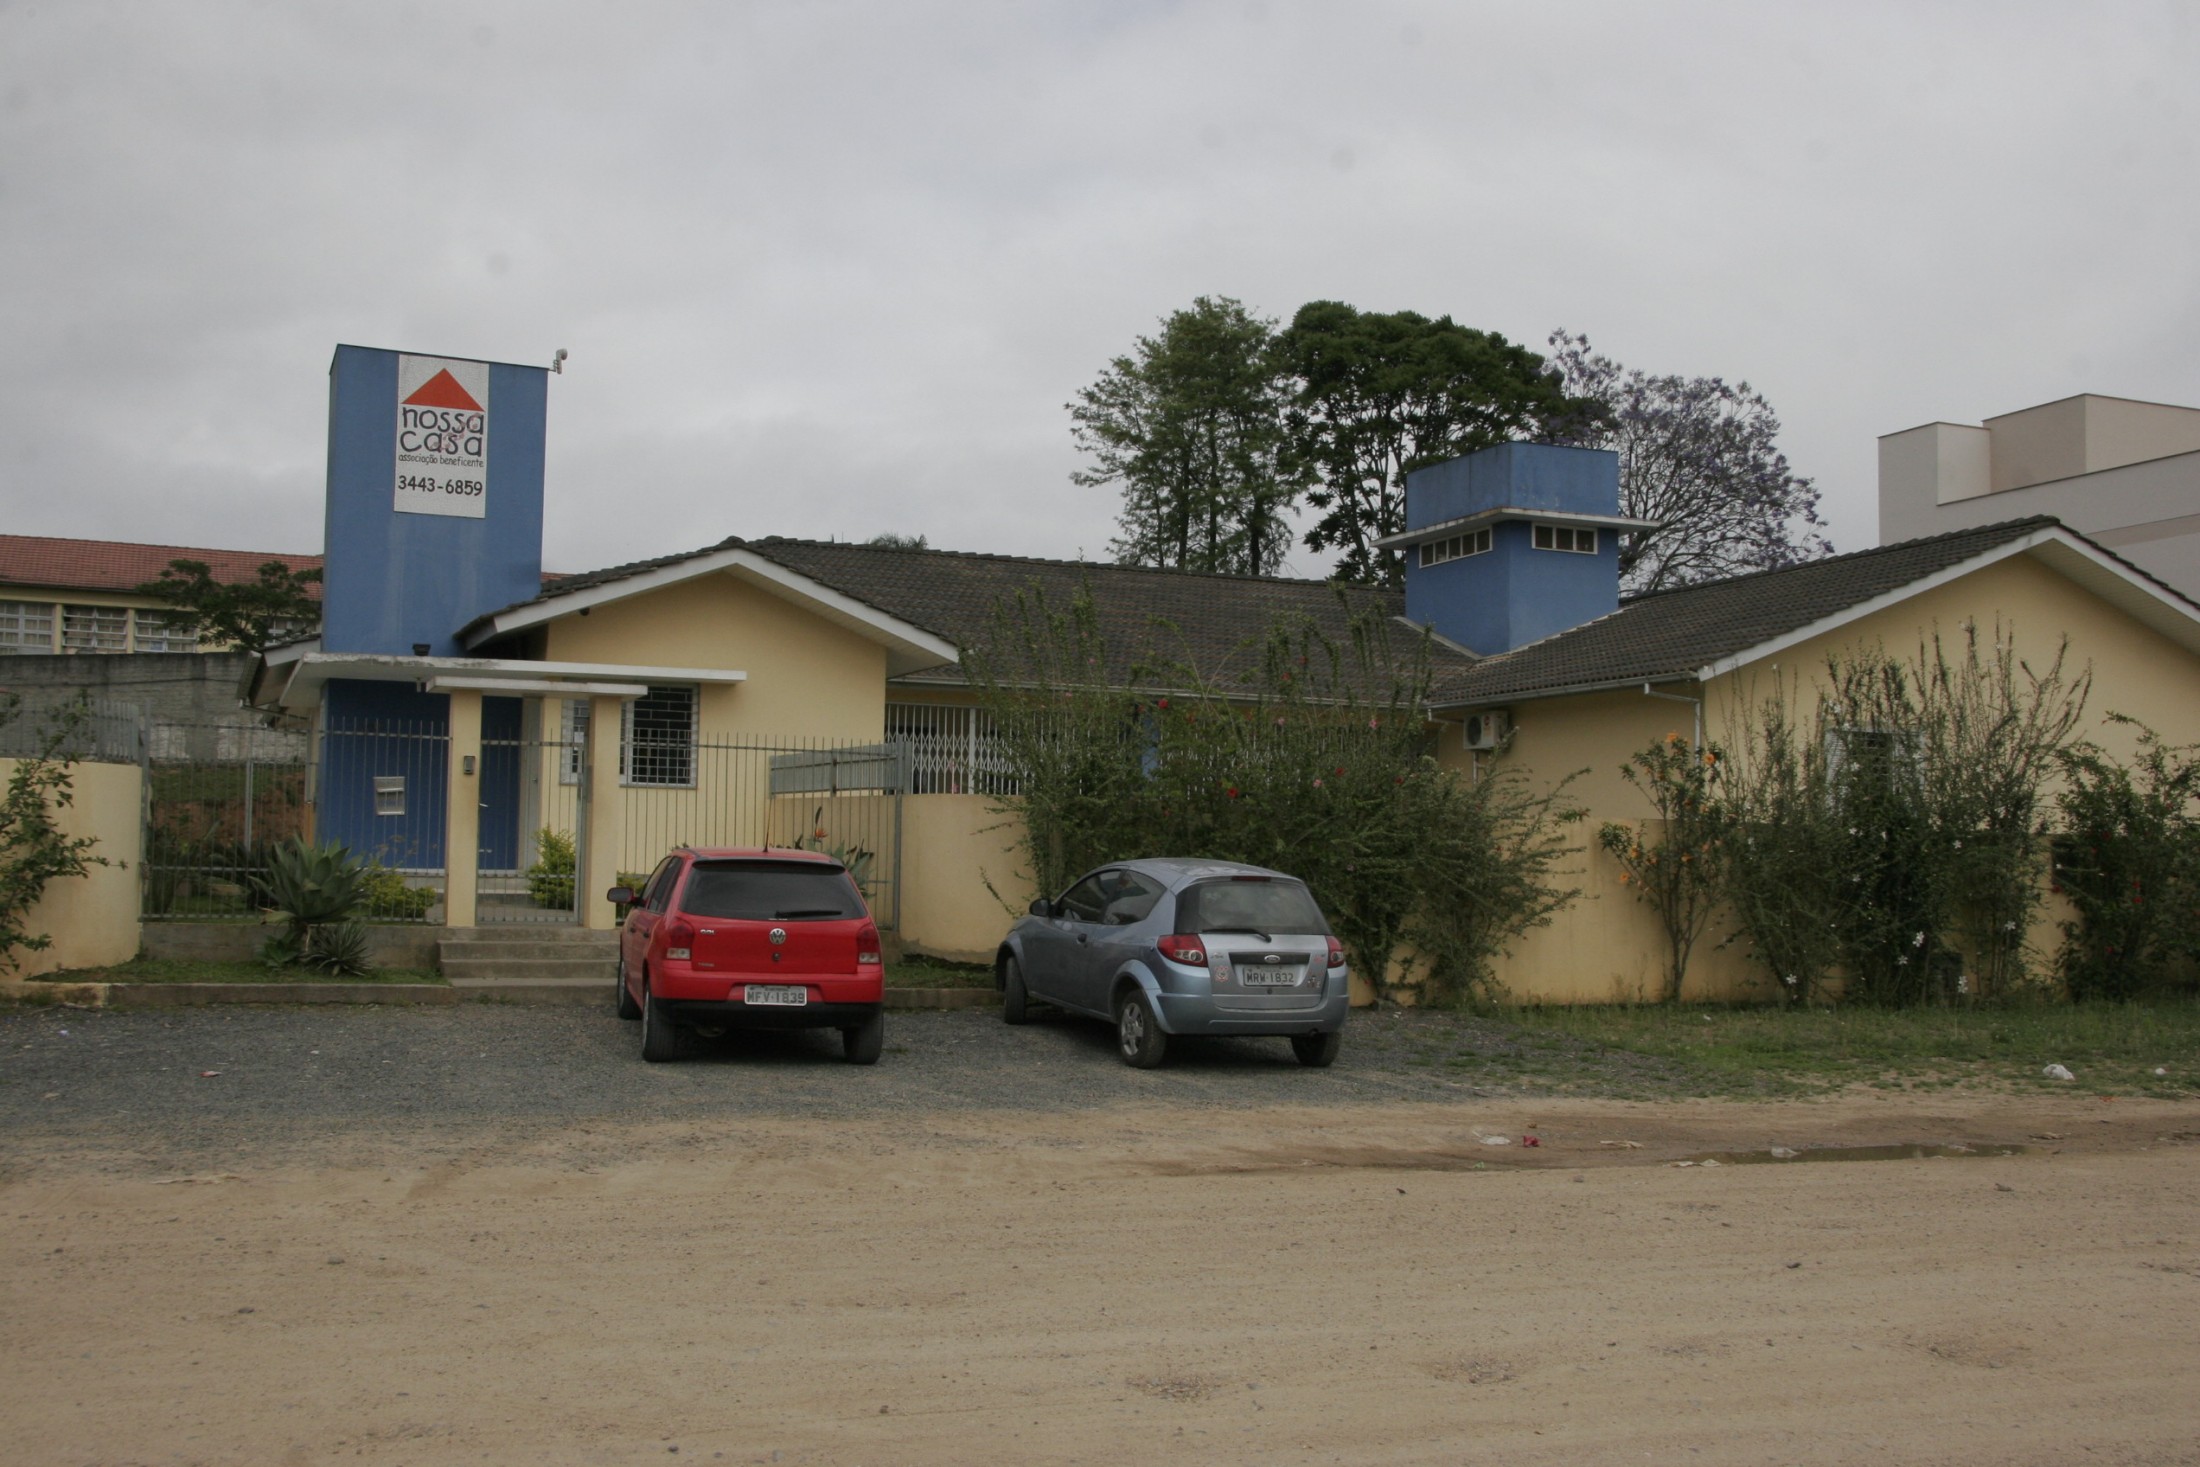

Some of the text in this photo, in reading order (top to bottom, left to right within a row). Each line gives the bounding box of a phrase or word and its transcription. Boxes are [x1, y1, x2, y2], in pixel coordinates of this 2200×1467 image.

[402, 407, 484, 435] nossa
[400, 430, 482, 457] casa
[399, 453, 484, 467] associação beneficente
[398, 475, 483, 496] 3443-6859
